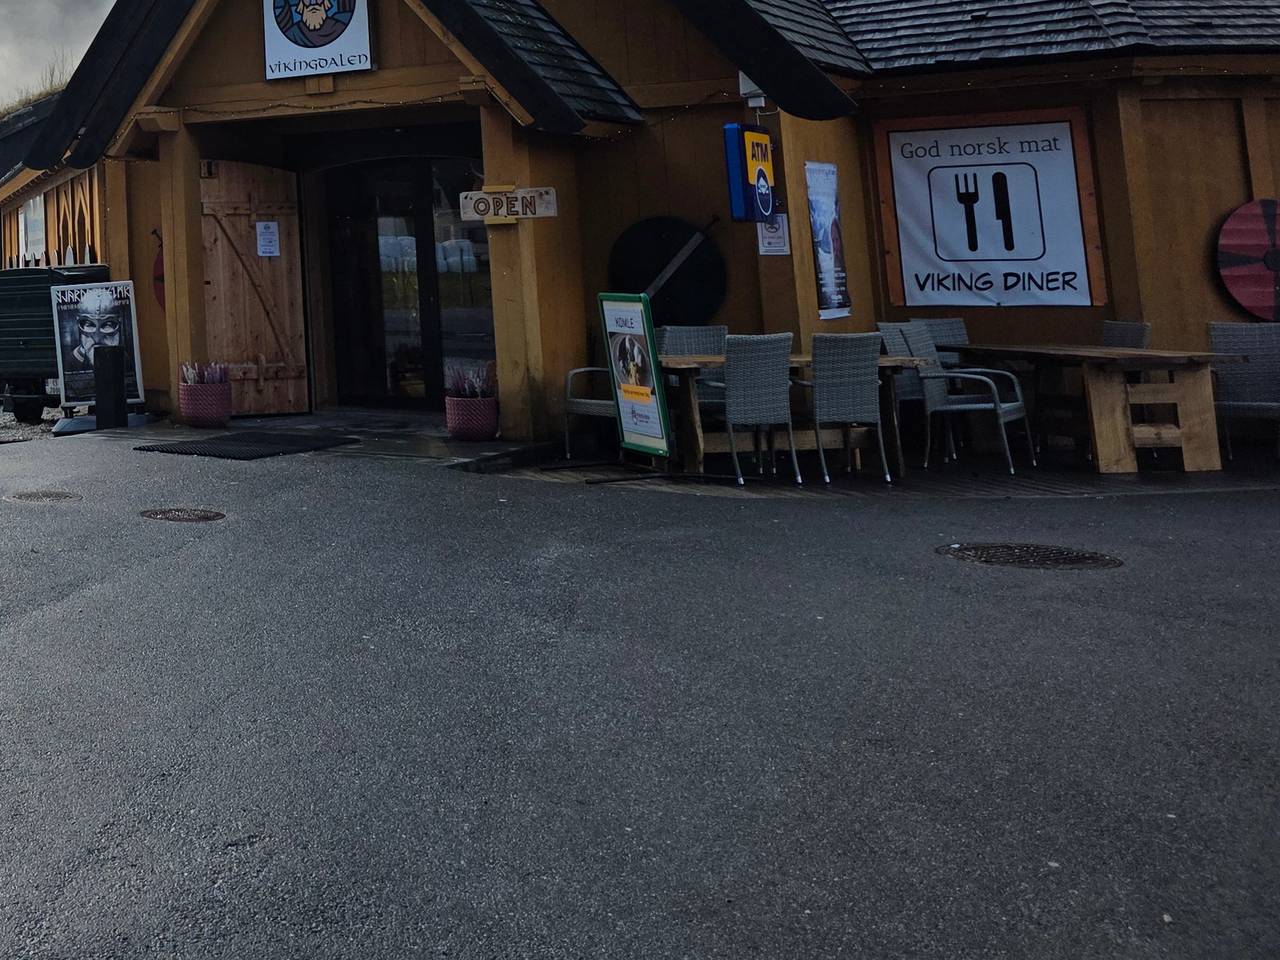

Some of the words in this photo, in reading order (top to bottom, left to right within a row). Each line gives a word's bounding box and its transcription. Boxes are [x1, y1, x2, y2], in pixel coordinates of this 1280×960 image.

[752, 142, 768, 161] ATM
[901, 140, 940, 158] God
[949, 137, 1010, 156] norsk
[1020, 136, 1061, 152] mat
[474, 196, 536, 216] OPEN
[915, 272, 993, 291] VIKING
[1004, 271, 1078, 290] DINER
